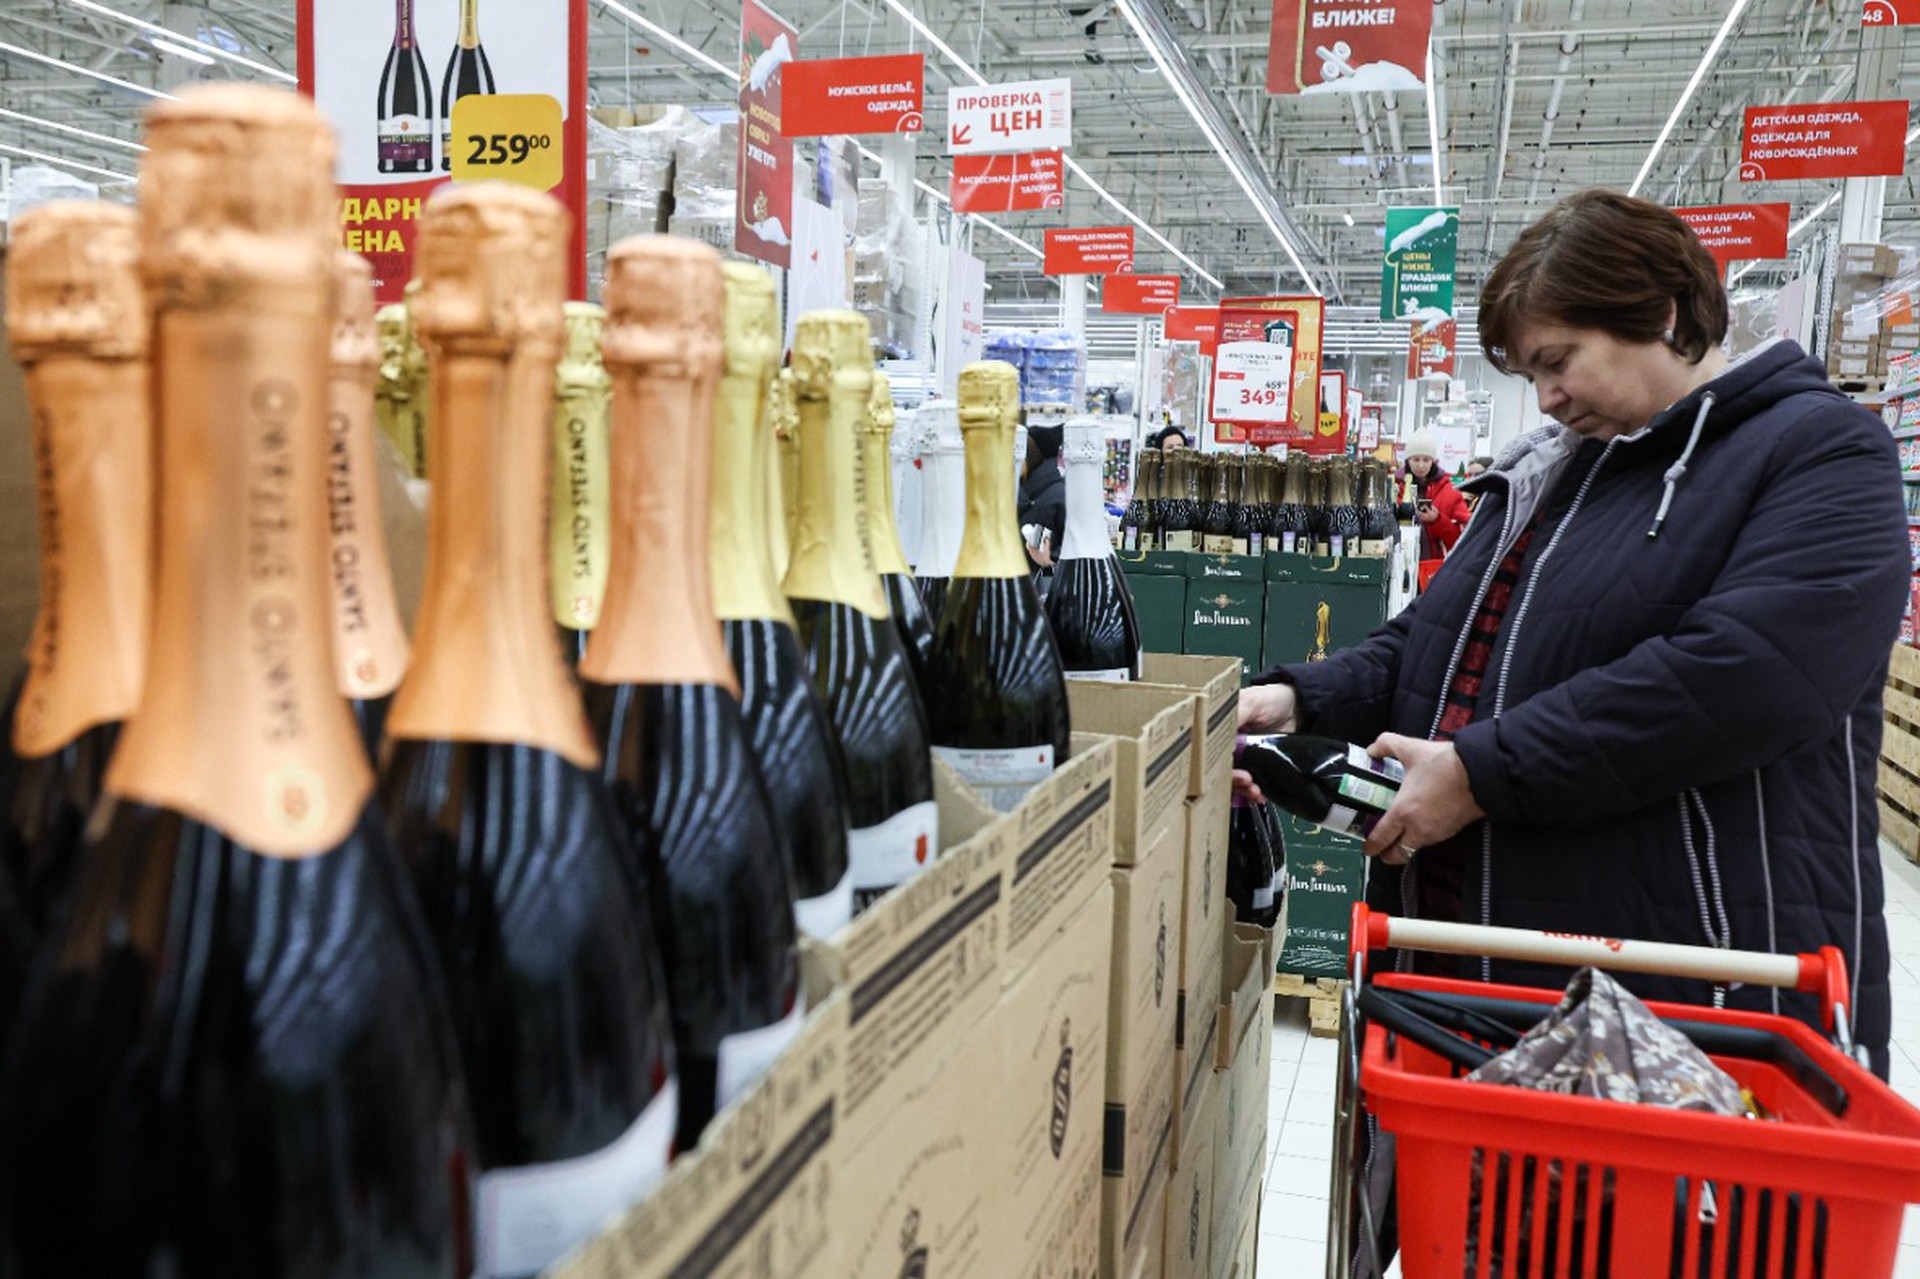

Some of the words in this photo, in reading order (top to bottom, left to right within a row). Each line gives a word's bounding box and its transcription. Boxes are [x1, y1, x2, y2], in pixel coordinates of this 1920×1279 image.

[1312, 8, 1396, 28] БЛИЖЕ!
[1863, 10, 1884, 23] 48
[828, 86, 878, 97] МУЖСКОЕ
[957, 91, 1042, 111] ПРОВЕРКА
[867, 100, 914, 112] ОДЕЖДА
[990, 109, 1042, 137] ЦЕН
[1752, 114, 1805, 128] ДЕТСКАЯ
[1807, 112, 1863, 125] ОДЕЖДА,
[1751, 132, 1803, 144] ОДЕЖДА
[1804, 130, 1830, 141] ДЛЯ
[1749, 145, 1858, 160] НОВОРОЖДЁННЫХ
[340, 197, 422, 225] ДАРН
[1679, 211, 1713, 222] ТСКАЯ
[1714, 212, 1755, 222] ОДЕЖДА,
[344, 230, 406, 252] ЕНА
[1240, 389, 1276, 405] 349
[567, 417, 589, 507] STEFANO
[326, 410, 359, 535] STEFANO
[571, 514, 592, 579] SANTO
[332, 544, 371, 634] SANTO
